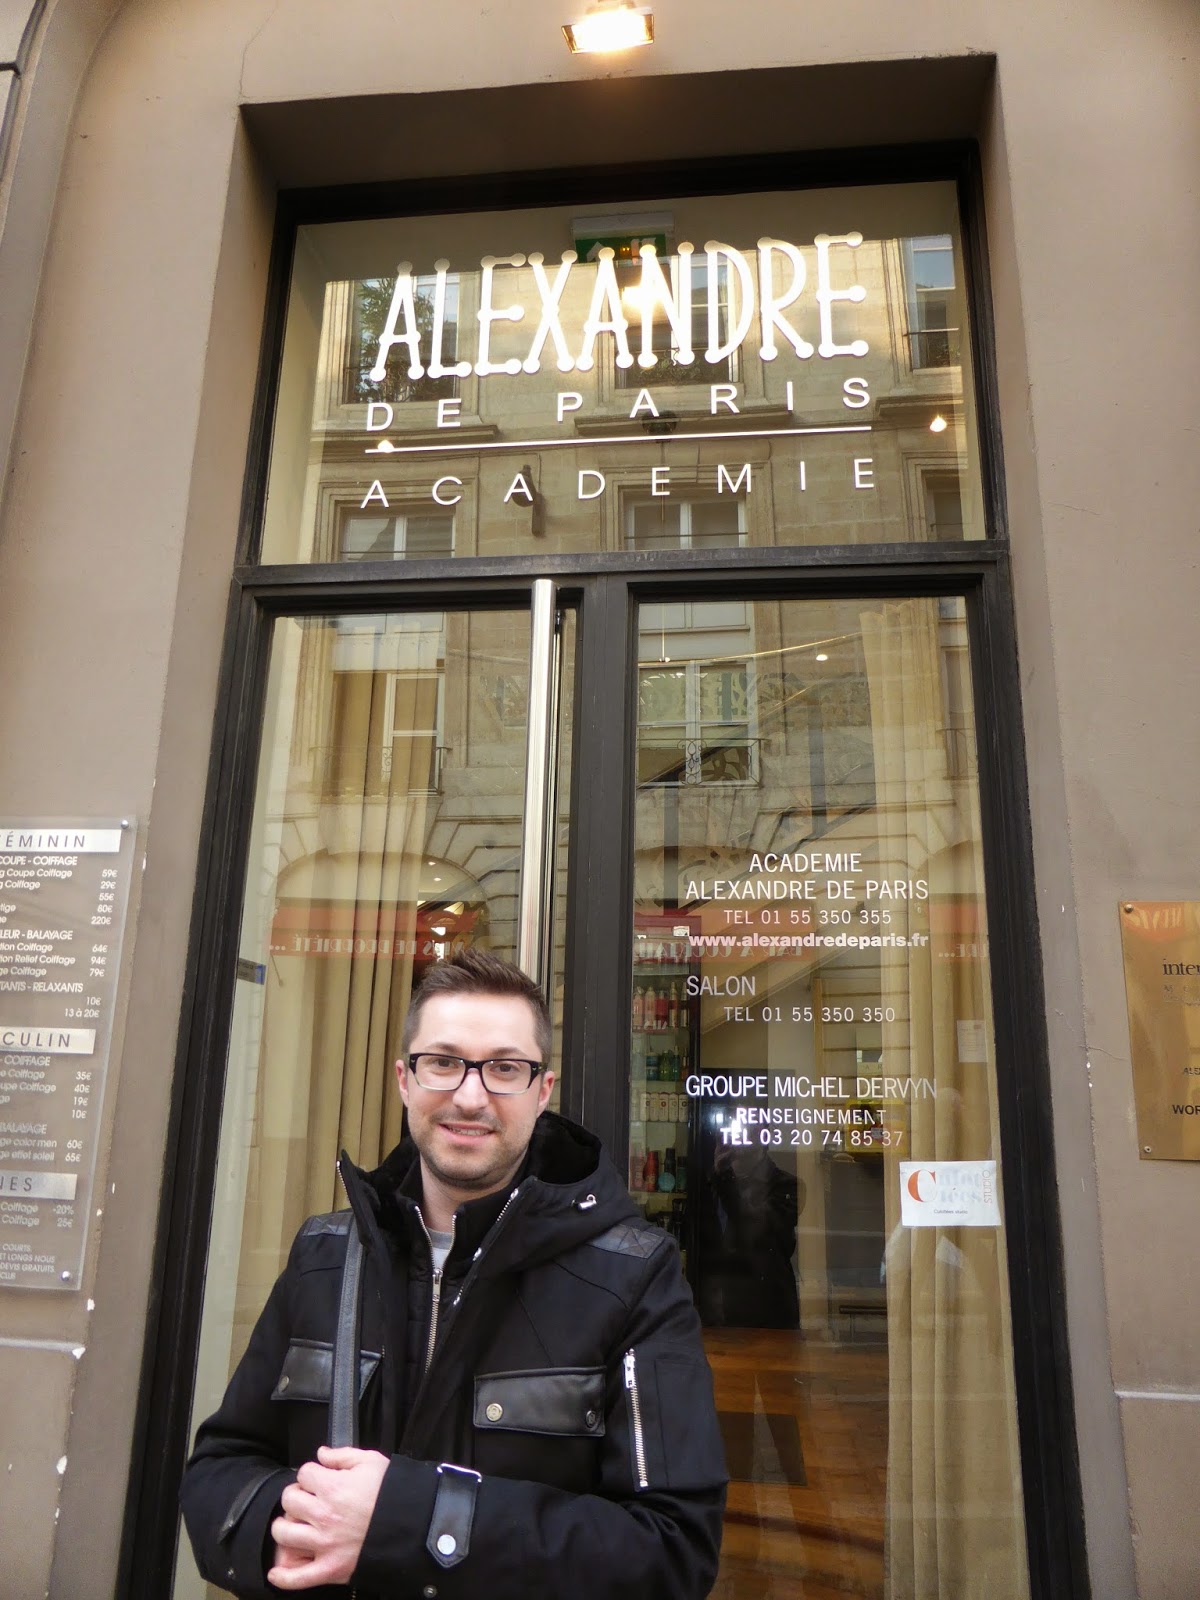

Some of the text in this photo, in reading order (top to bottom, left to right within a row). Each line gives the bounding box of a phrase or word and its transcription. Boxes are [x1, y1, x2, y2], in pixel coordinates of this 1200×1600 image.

[369, 231, 869, 381] ALEXANDRE
[366, 377, 872, 432] DE PARIS
[360, 458, 876, 509] ACADEMIE
[0, 830, 85, 848] ÉMININ
[33, 856, 78, 866] COIFFAGE
[749, 853, 863, 873] ACADEMIE
[6, 869, 35, 878] Coupe
[36, 869, 73, 879] Coiffage
[102, 869, 118, 878] 59€
[4, 880, 41, 890] Coiffage
[100, 881, 116, 890] 29€
[685, 879, 929, 900] ALEXANDRE DE PARIS
[90, 916, 112, 925] 220€
[723, 909, 892, 925] TEL 01 55 350 355
[26, 930, 73, 940] BALAYAGE
[688, 932, 929, 950] www.alexandredeparis.fr
[16, 943, 53, 953] Coiffage
[92, 944, 108, 953] 64€
[39, 955, 76, 966] Coiffage
[90, 956, 107, 965] 94€
[10, 966, 47, 977] Coiffage
[89, 968, 105, 977] 79€
[32, 982, 84, 993] RELAXANTS
[686, 975, 756, 997] SALON
[86, 996, 101, 1005] 10€
[65, 1008, 100, 1018] 13 à 20€
[724, 1006, 895, 1022] TEL 01 55 350 350
[2, 1031, 71, 1048] CULIN
[4, 1055, 51, 1066] COIFFAGE
[8, 1068, 46, 1080] Coiffage
[75, 1071, 92, 1080] 35€
[19, 1082, 57, 1094] Coiffage
[74, 1084, 91, 1093] 40€
[685, 1074, 938, 1099] GROUPE MICHEL DERVYN
[73, 1096, 89, 1106] 19€
[71, 1109, 87, 1119] 10€
[736, 1107, 887, 1125] RENSEIGNEMENT
[719, 1127, 903, 1147] TEL 03 20 74 85 37
[66, 1139, 83, 1149] 60€
[65, 1153, 82, 1163] 65€
[2, 1215, 40, 1227] Coiffage
